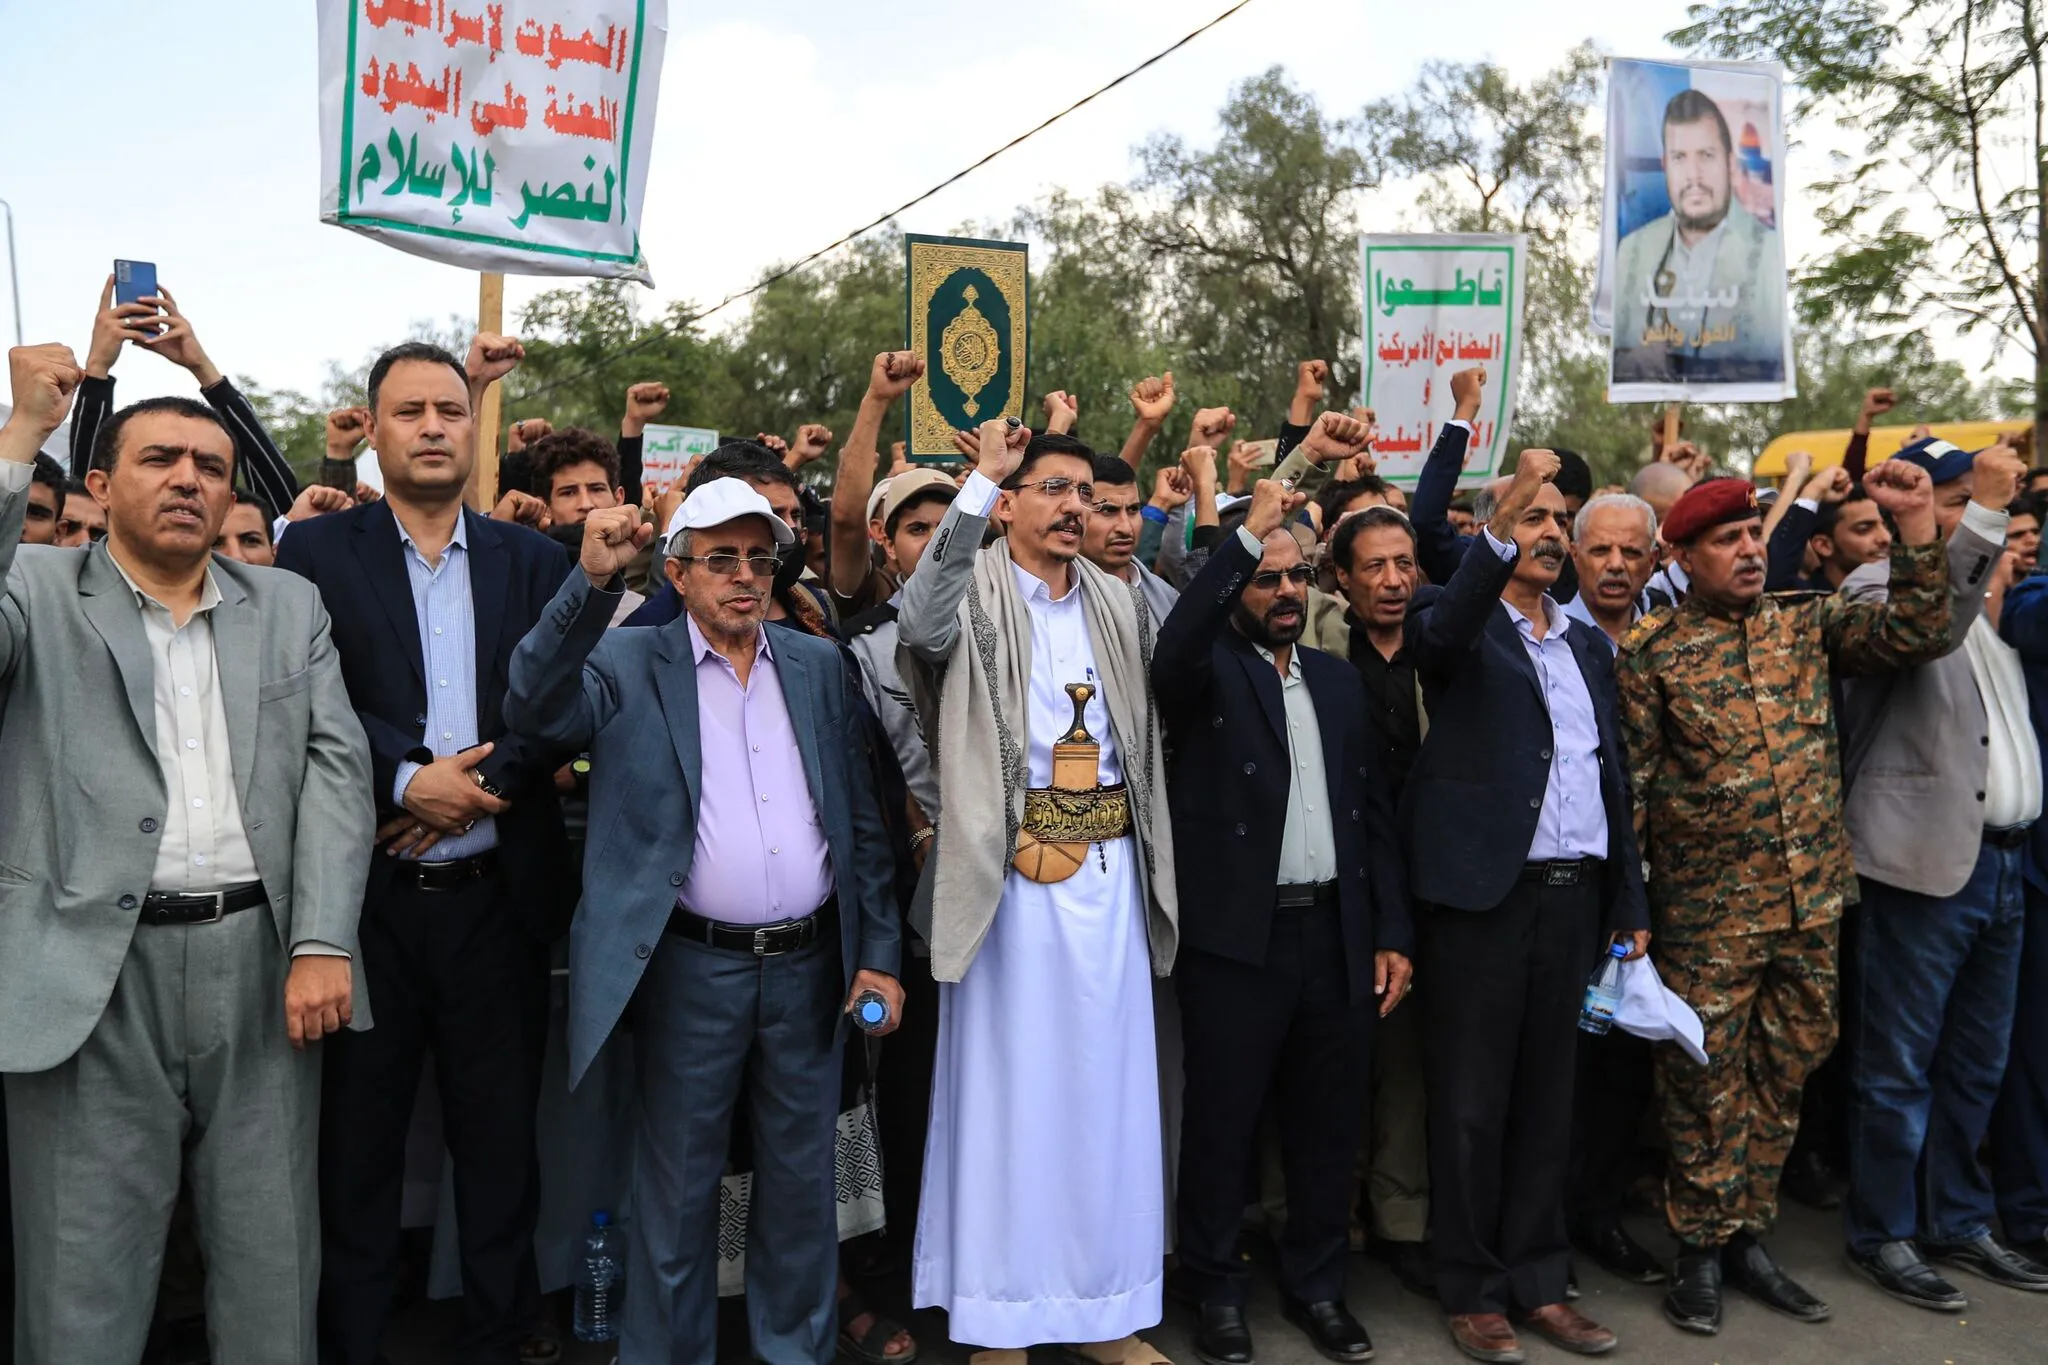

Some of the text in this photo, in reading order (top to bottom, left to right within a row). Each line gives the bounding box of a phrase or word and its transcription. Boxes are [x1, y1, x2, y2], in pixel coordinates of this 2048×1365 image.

[515, 17, 627, 74] الموت
[361, 53, 618, 144] اللعنة على اليهود
[357, 126, 627, 230] النصر للإسلام
[1376, 267, 1502, 317] قاطعوا
[1436, 328, 1501, 367] البضائع
